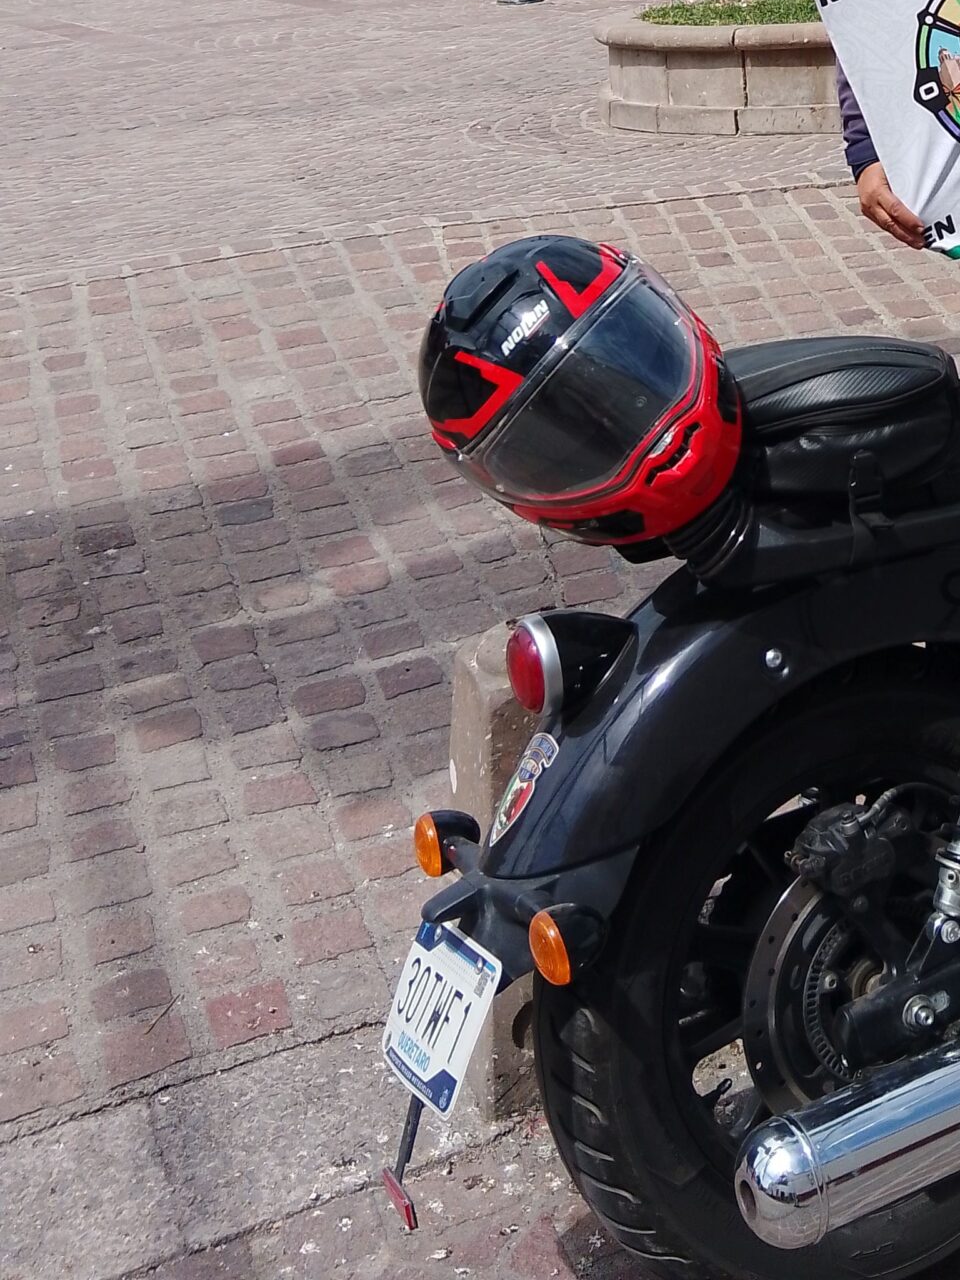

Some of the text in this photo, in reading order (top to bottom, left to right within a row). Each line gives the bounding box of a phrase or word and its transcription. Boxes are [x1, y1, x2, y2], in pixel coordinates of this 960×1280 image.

[919, 81, 939, 100] O
[922, 215, 956, 248] EN
[500, 299, 550, 357] NOLAN
